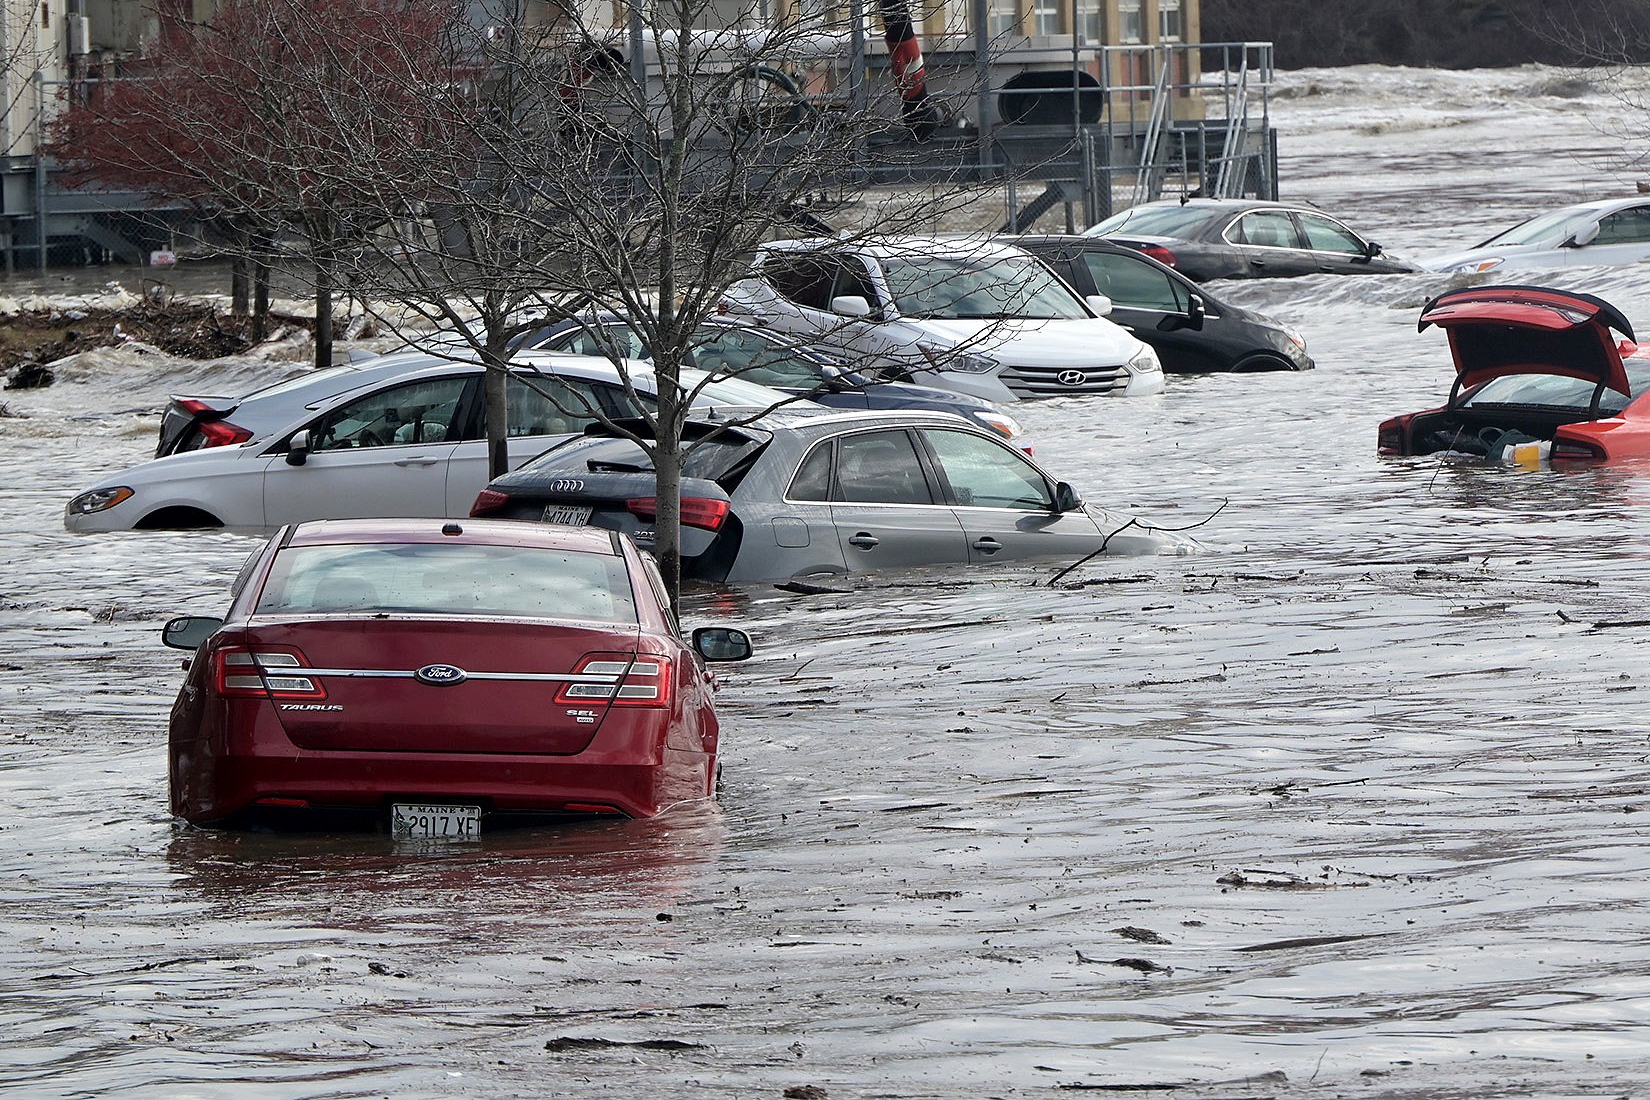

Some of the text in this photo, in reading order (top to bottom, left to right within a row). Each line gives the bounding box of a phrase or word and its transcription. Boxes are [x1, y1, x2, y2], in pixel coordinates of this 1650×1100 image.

[427, 666, 453, 678] Ford
[565, 709, 599, 717] SEL
[417, 806, 457, 814] MAINE
[408, 815, 450, 837] 2917
